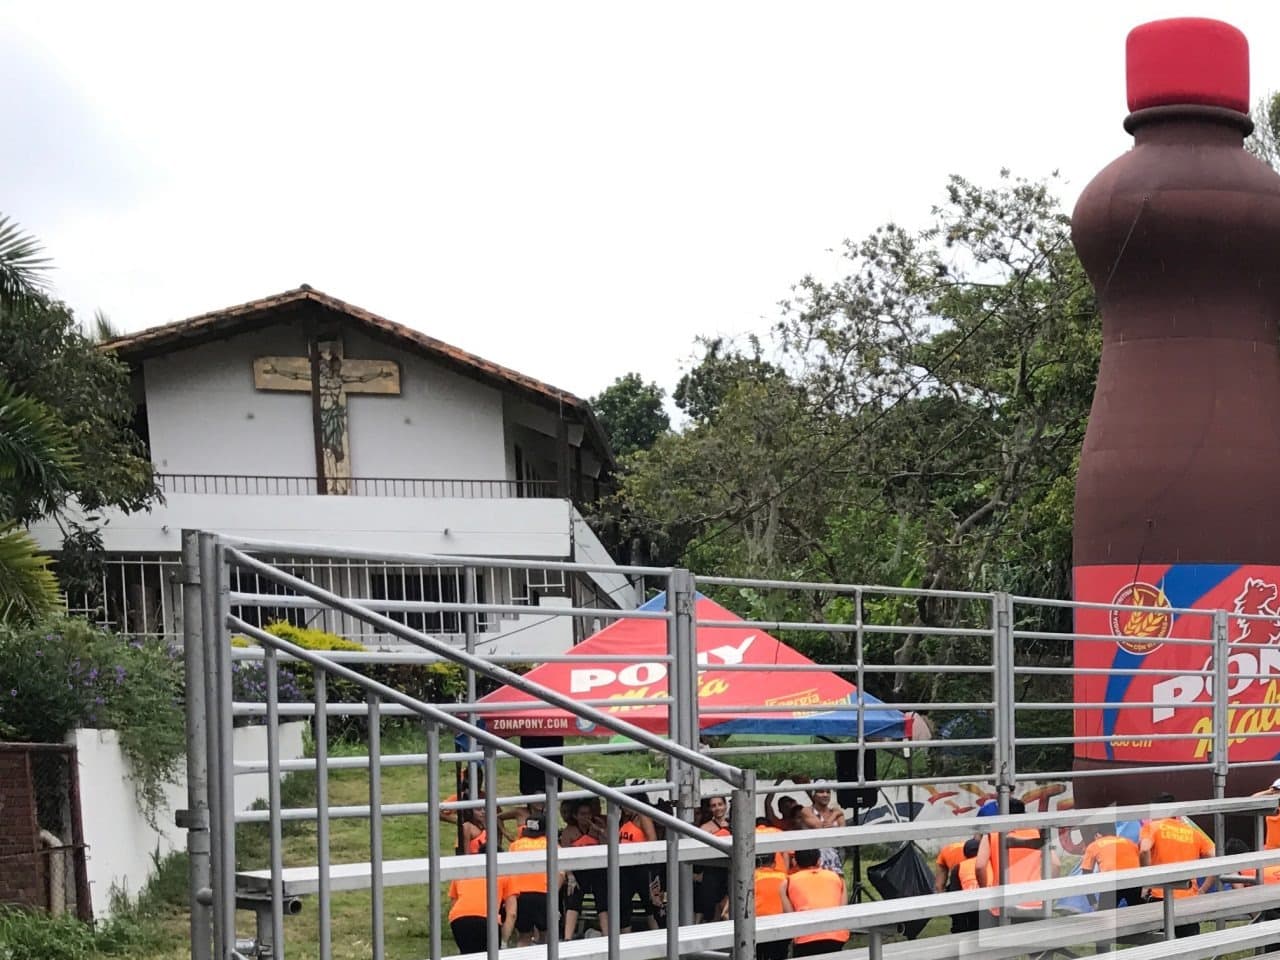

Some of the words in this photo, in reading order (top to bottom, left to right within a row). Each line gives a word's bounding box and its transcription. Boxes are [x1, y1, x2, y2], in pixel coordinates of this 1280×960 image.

[571, 635, 757, 693] POY
[608, 675, 729, 713] Maa
[494, 718, 568, 729] ZONAPONY.COM
